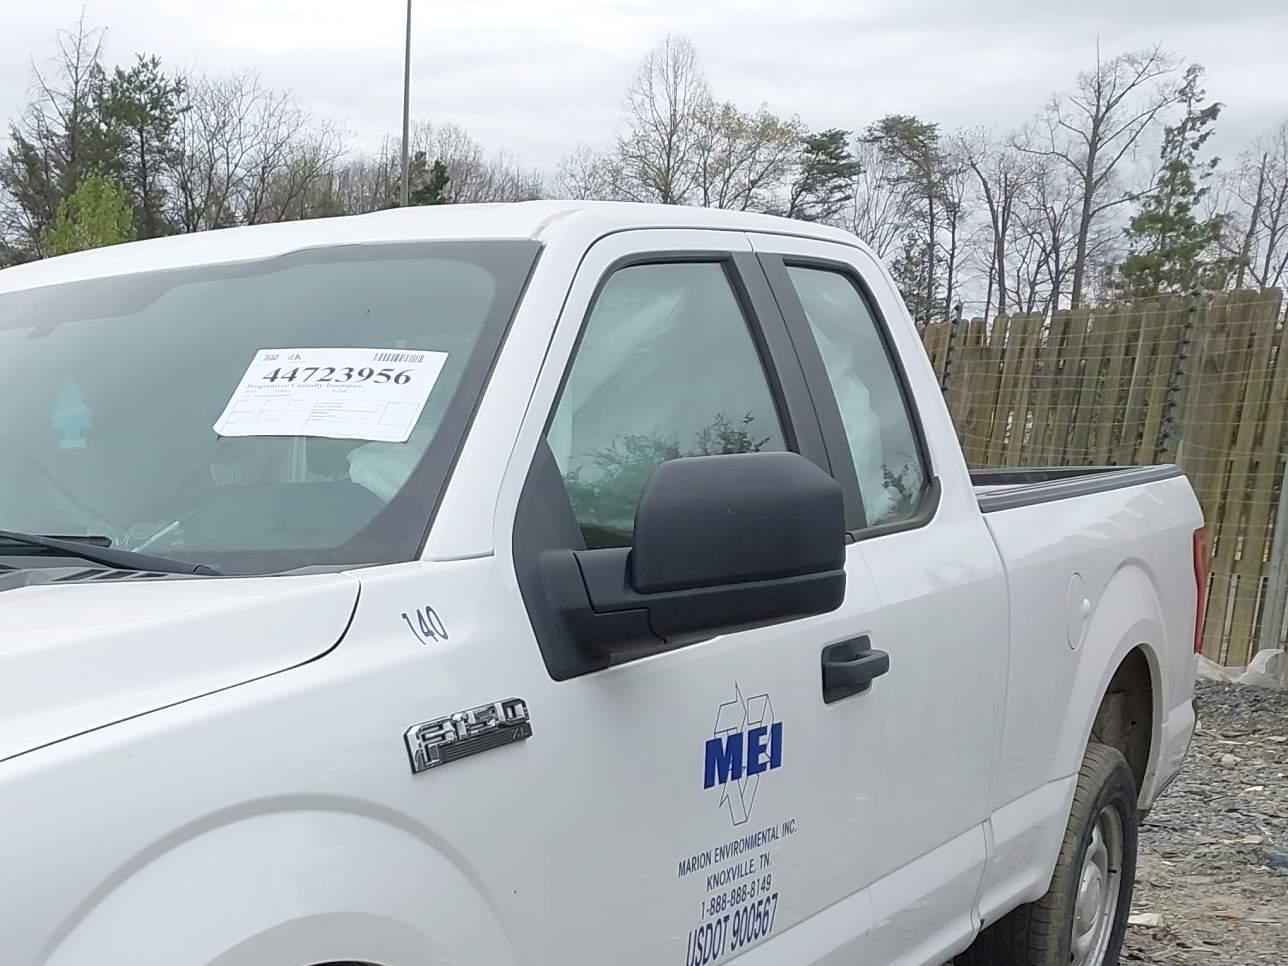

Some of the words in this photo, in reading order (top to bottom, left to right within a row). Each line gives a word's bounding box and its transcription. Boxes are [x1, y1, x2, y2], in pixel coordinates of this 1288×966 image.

[262, 366, 414, 385] 44723956
[703, 721, 783, 790] MEI
[678, 849, 712, 878] MARION
[714, 827, 780, 864] ENVIRONMENTAL
[706, 858, 757, 892] KNOXVILLE,
[701, 873, 772, 921] 1-888-888-8149
[731, 893, 779, 951] 900567
